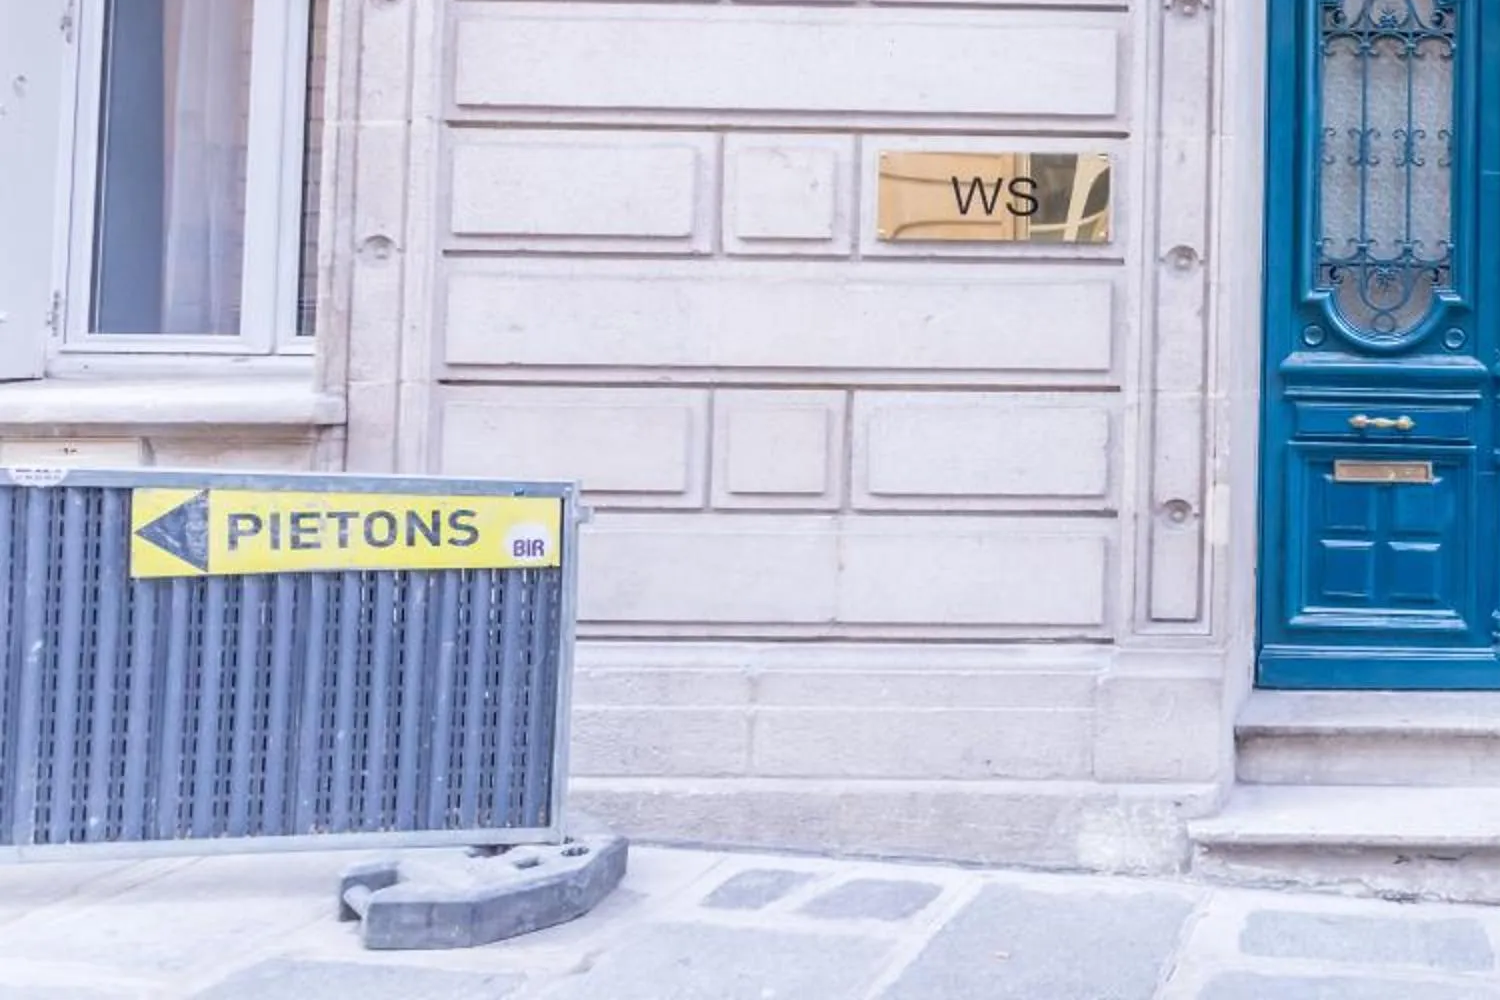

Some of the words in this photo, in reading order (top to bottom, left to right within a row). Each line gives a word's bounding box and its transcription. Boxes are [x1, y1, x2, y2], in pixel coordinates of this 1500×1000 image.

[951, 175, 1039, 216] WS
[227, 509, 479, 550] PIETONS
[513, 539, 545, 557] BIR
